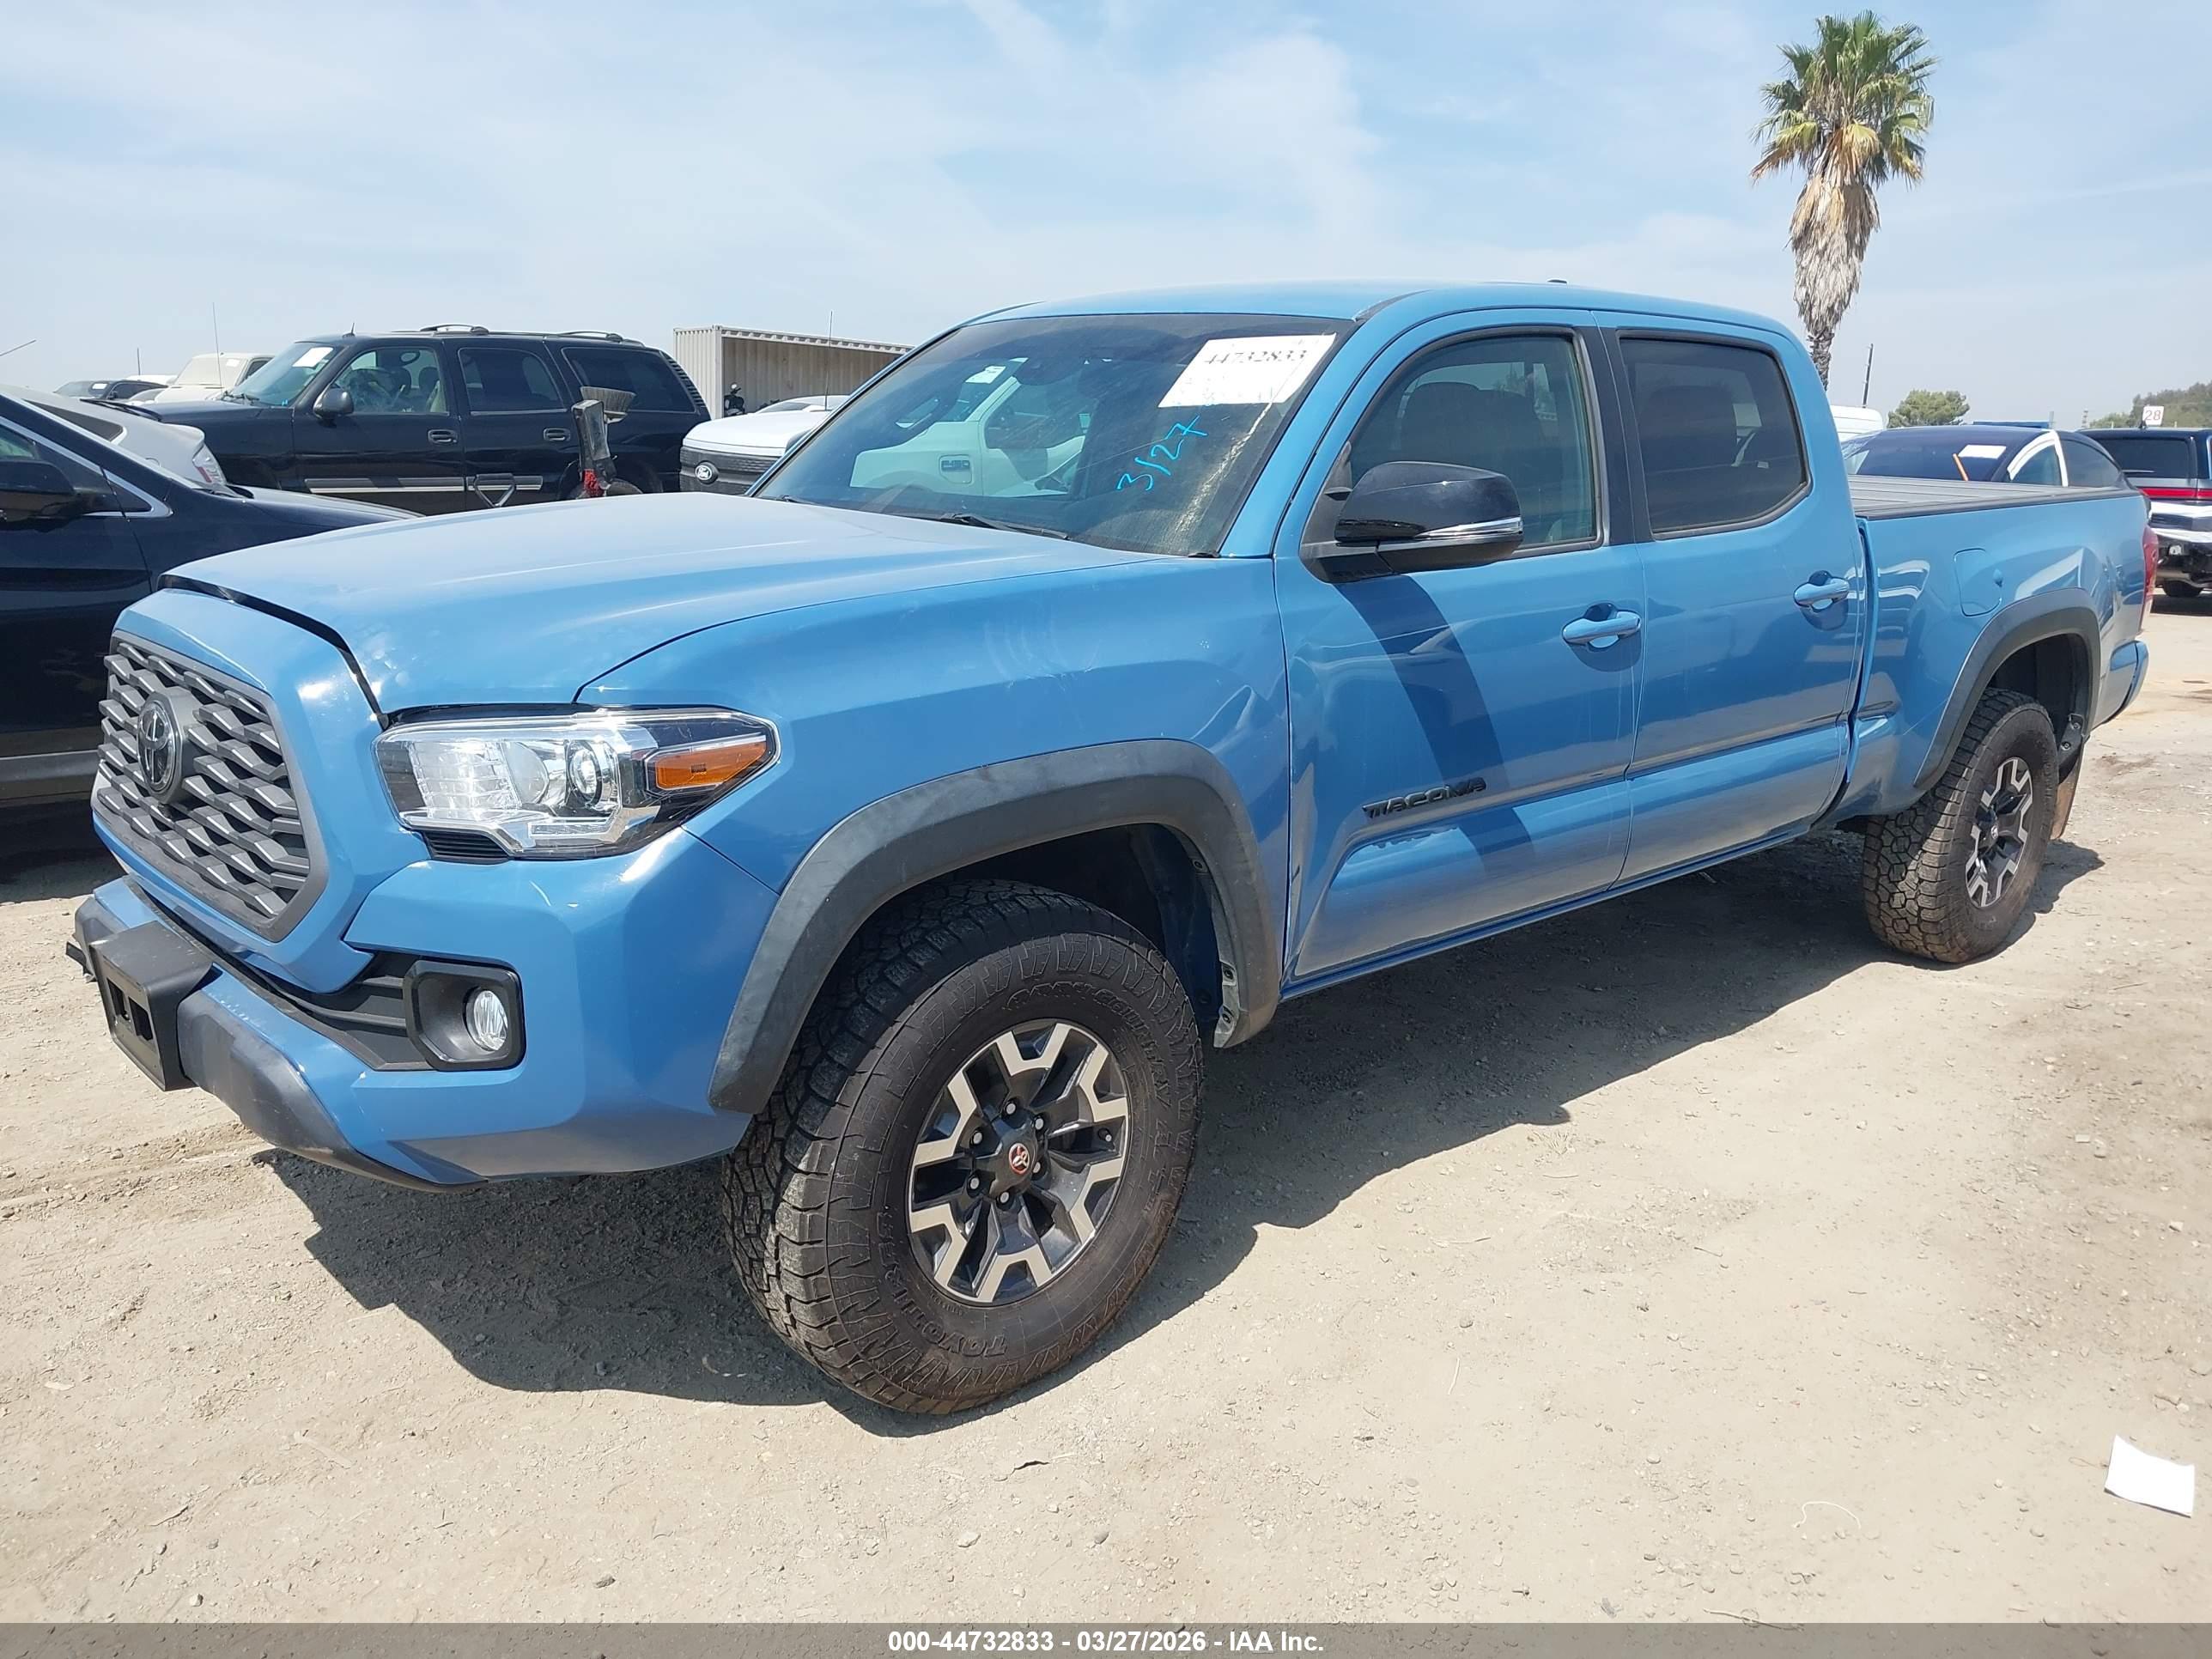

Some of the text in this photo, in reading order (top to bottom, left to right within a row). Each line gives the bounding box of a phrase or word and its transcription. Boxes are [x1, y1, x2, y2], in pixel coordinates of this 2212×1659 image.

[2145, 410, 2161, 421] 28
[1116, 414, 1208, 492] 3/27
[1362, 777, 1486, 818] TACOMA
